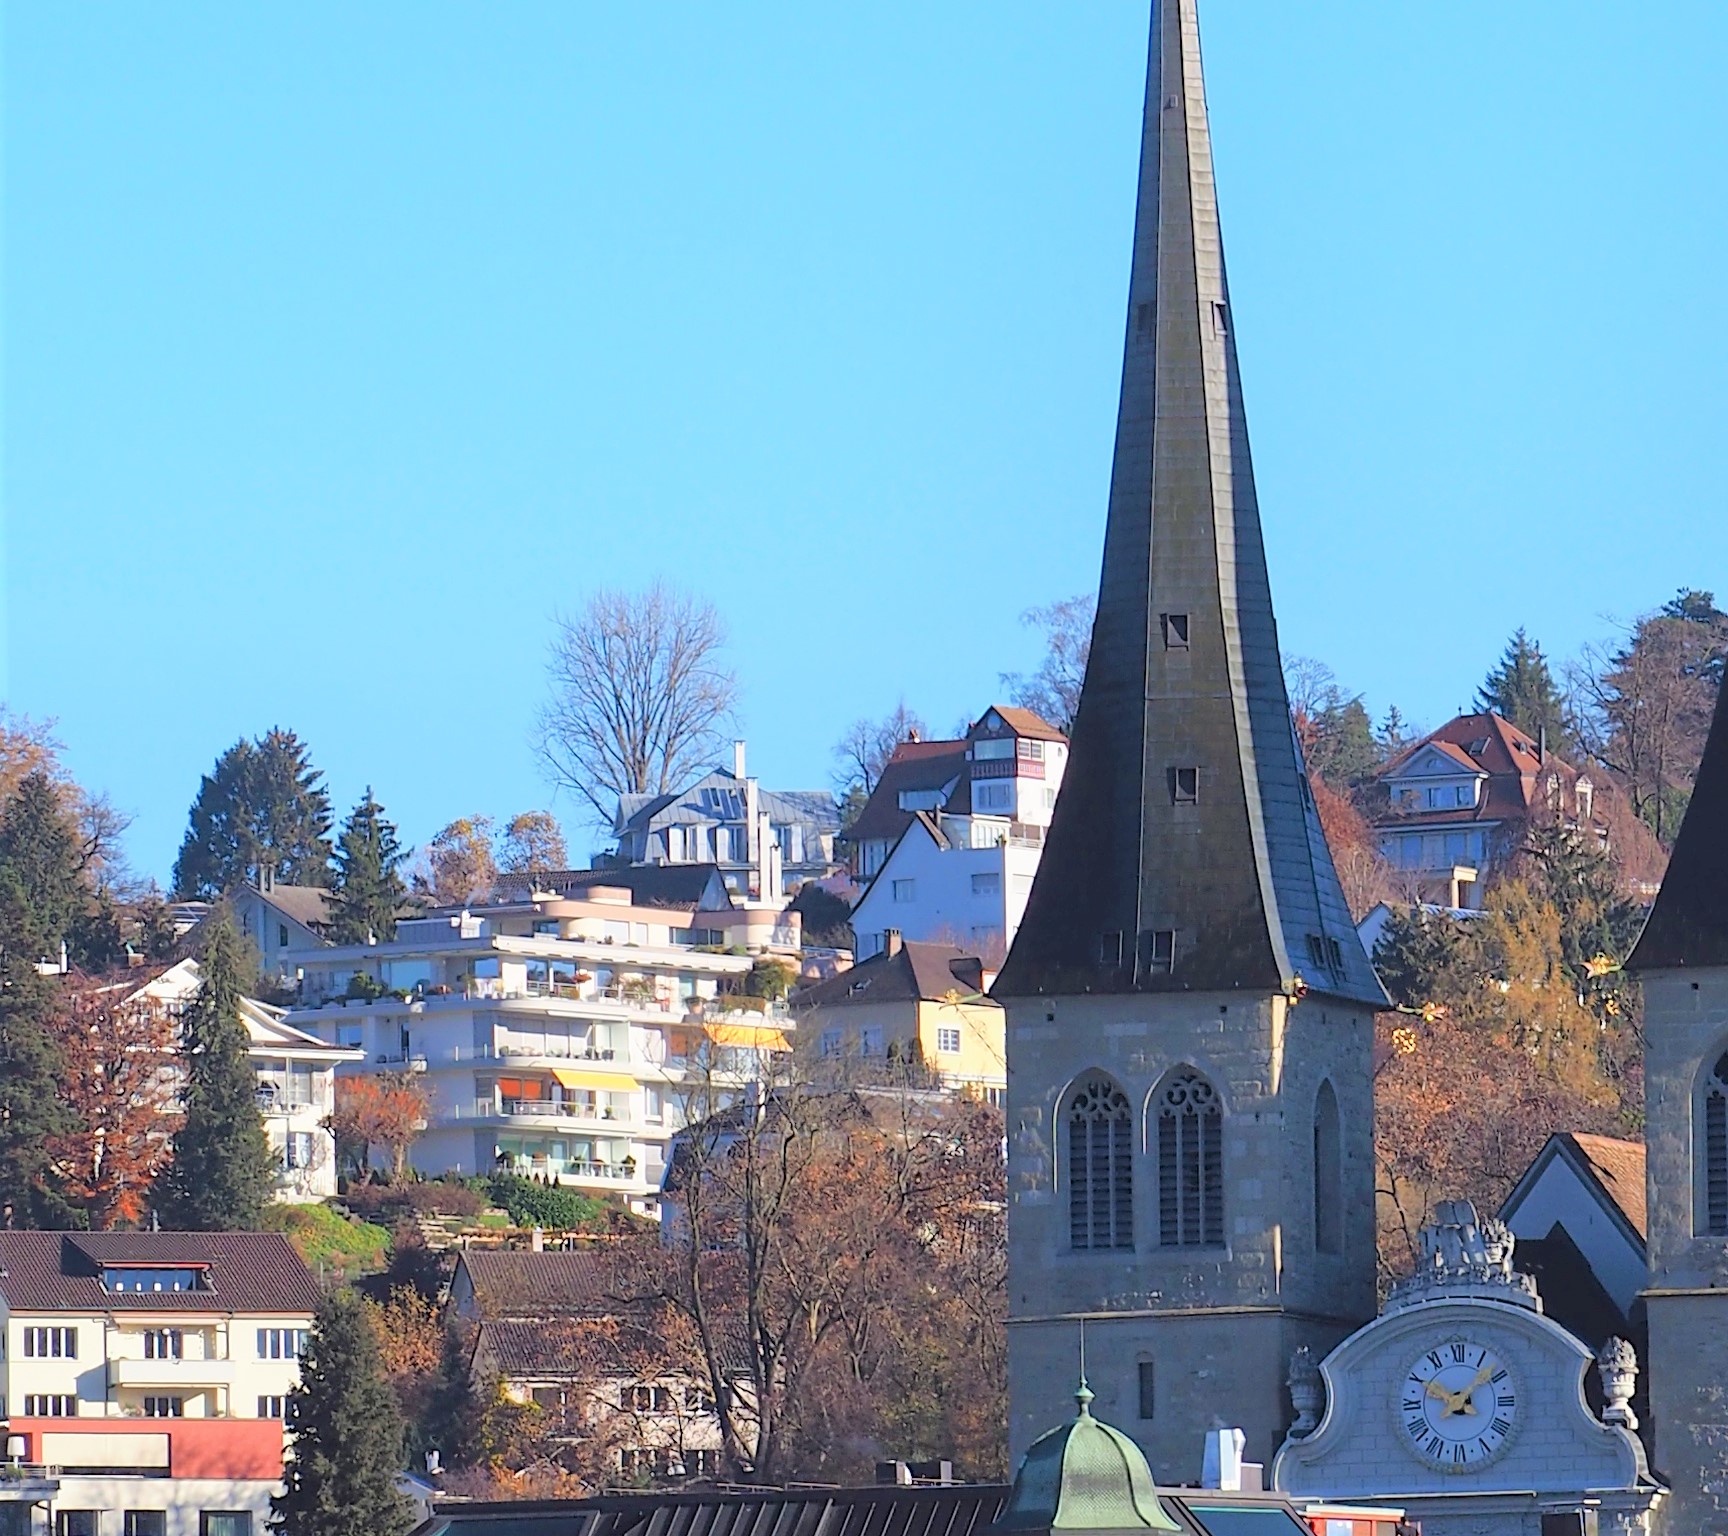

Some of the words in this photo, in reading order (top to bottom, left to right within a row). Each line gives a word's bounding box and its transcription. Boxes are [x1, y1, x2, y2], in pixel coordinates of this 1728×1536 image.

[1426, 1350, 1443, 1371] XI
[1451, 1345, 1464, 1362] XII
[1476, 1350, 1487, 1368] I
[1491, 1369, 1508, 1384] II
[1403, 1398, 1421, 1411] IX
[1497, 1395, 1515, 1407] III
[1425, 1436, 1444, 1459] VII
[1454, 1444, 1467, 1463] VI
[1478, 1437, 1491, 1457] V
